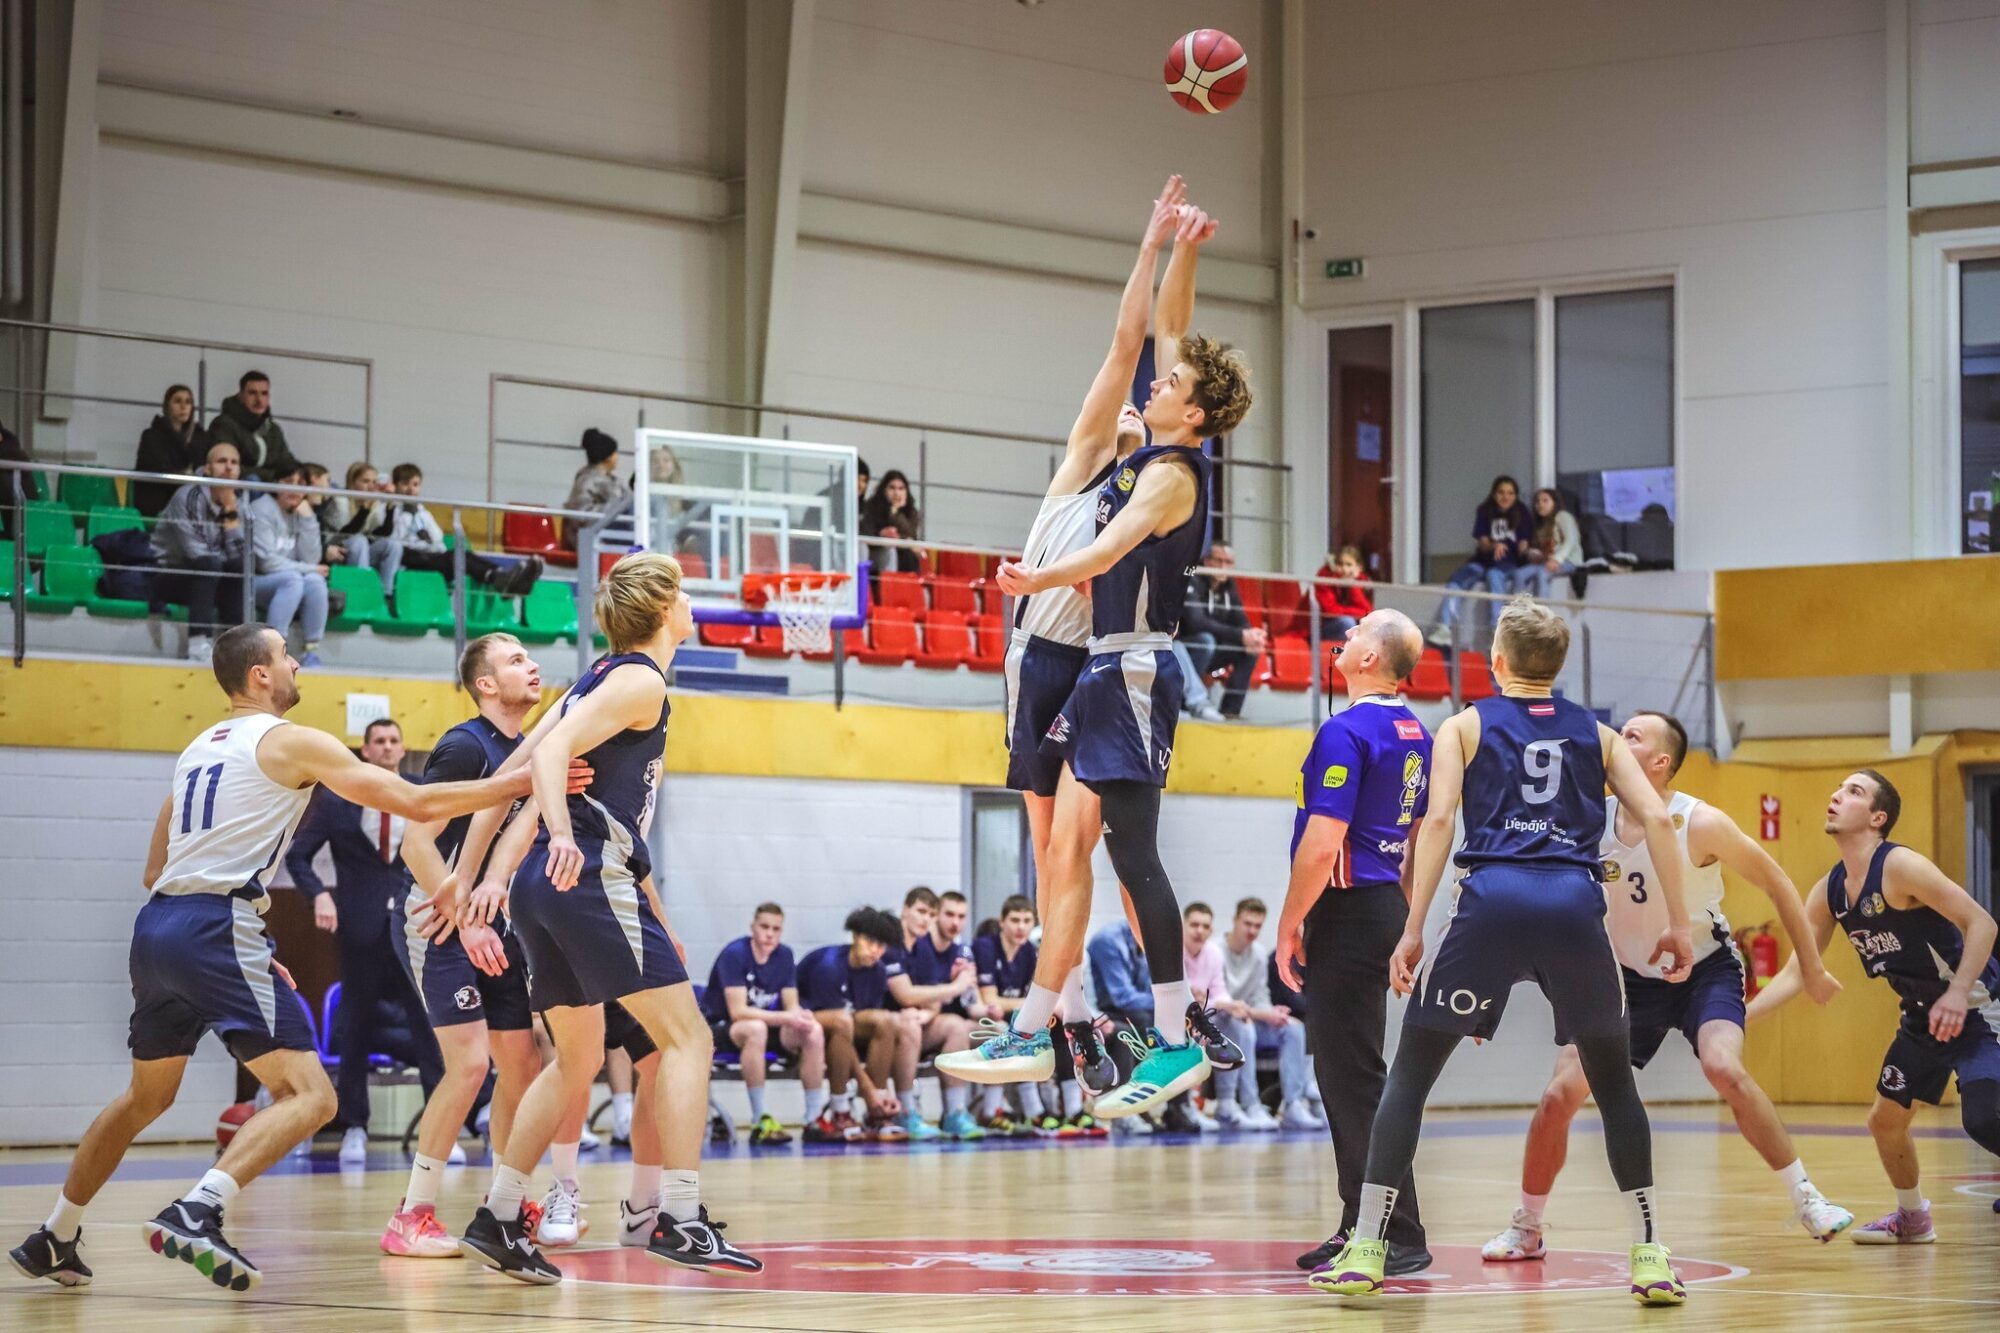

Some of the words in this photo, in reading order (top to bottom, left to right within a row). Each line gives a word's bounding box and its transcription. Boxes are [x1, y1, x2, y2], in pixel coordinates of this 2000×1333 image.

[1325, 775, 1344, 783] LEMON
[1521, 738, 1569, 804] 9
[181, 763, 224, 834] 11
[1504, 817, 1548, 833] Liepāja
[1627, 871, 1647, 904] 3
[1877, 940, 1902, 954] LSSS
[1362, 1249, 1384, 1258] DAM
